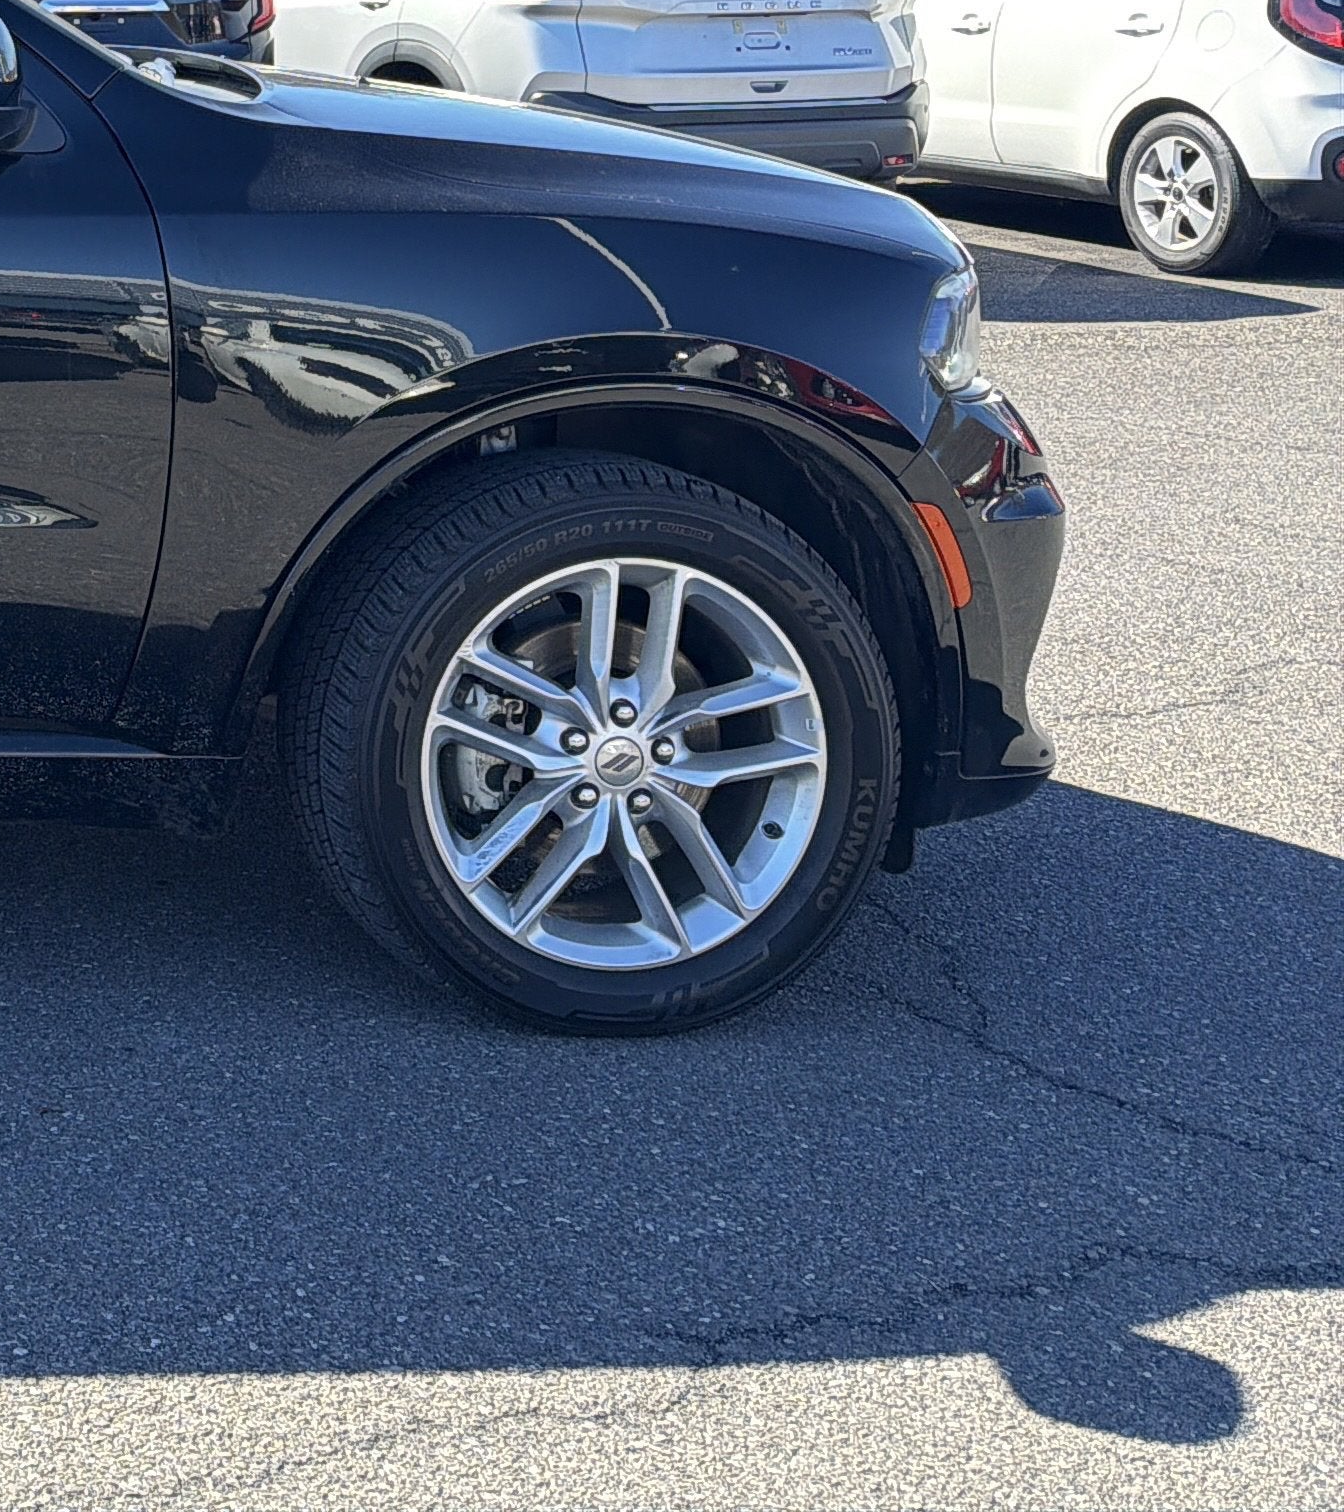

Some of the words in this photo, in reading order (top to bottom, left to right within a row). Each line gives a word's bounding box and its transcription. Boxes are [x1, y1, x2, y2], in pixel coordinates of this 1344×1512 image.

[483, 537, 548, 583] 265/50
[554, 524, 594, 547] R20
[602, 518, 653, 535] 111T
[816, 778, 878, 912] KUMHO
